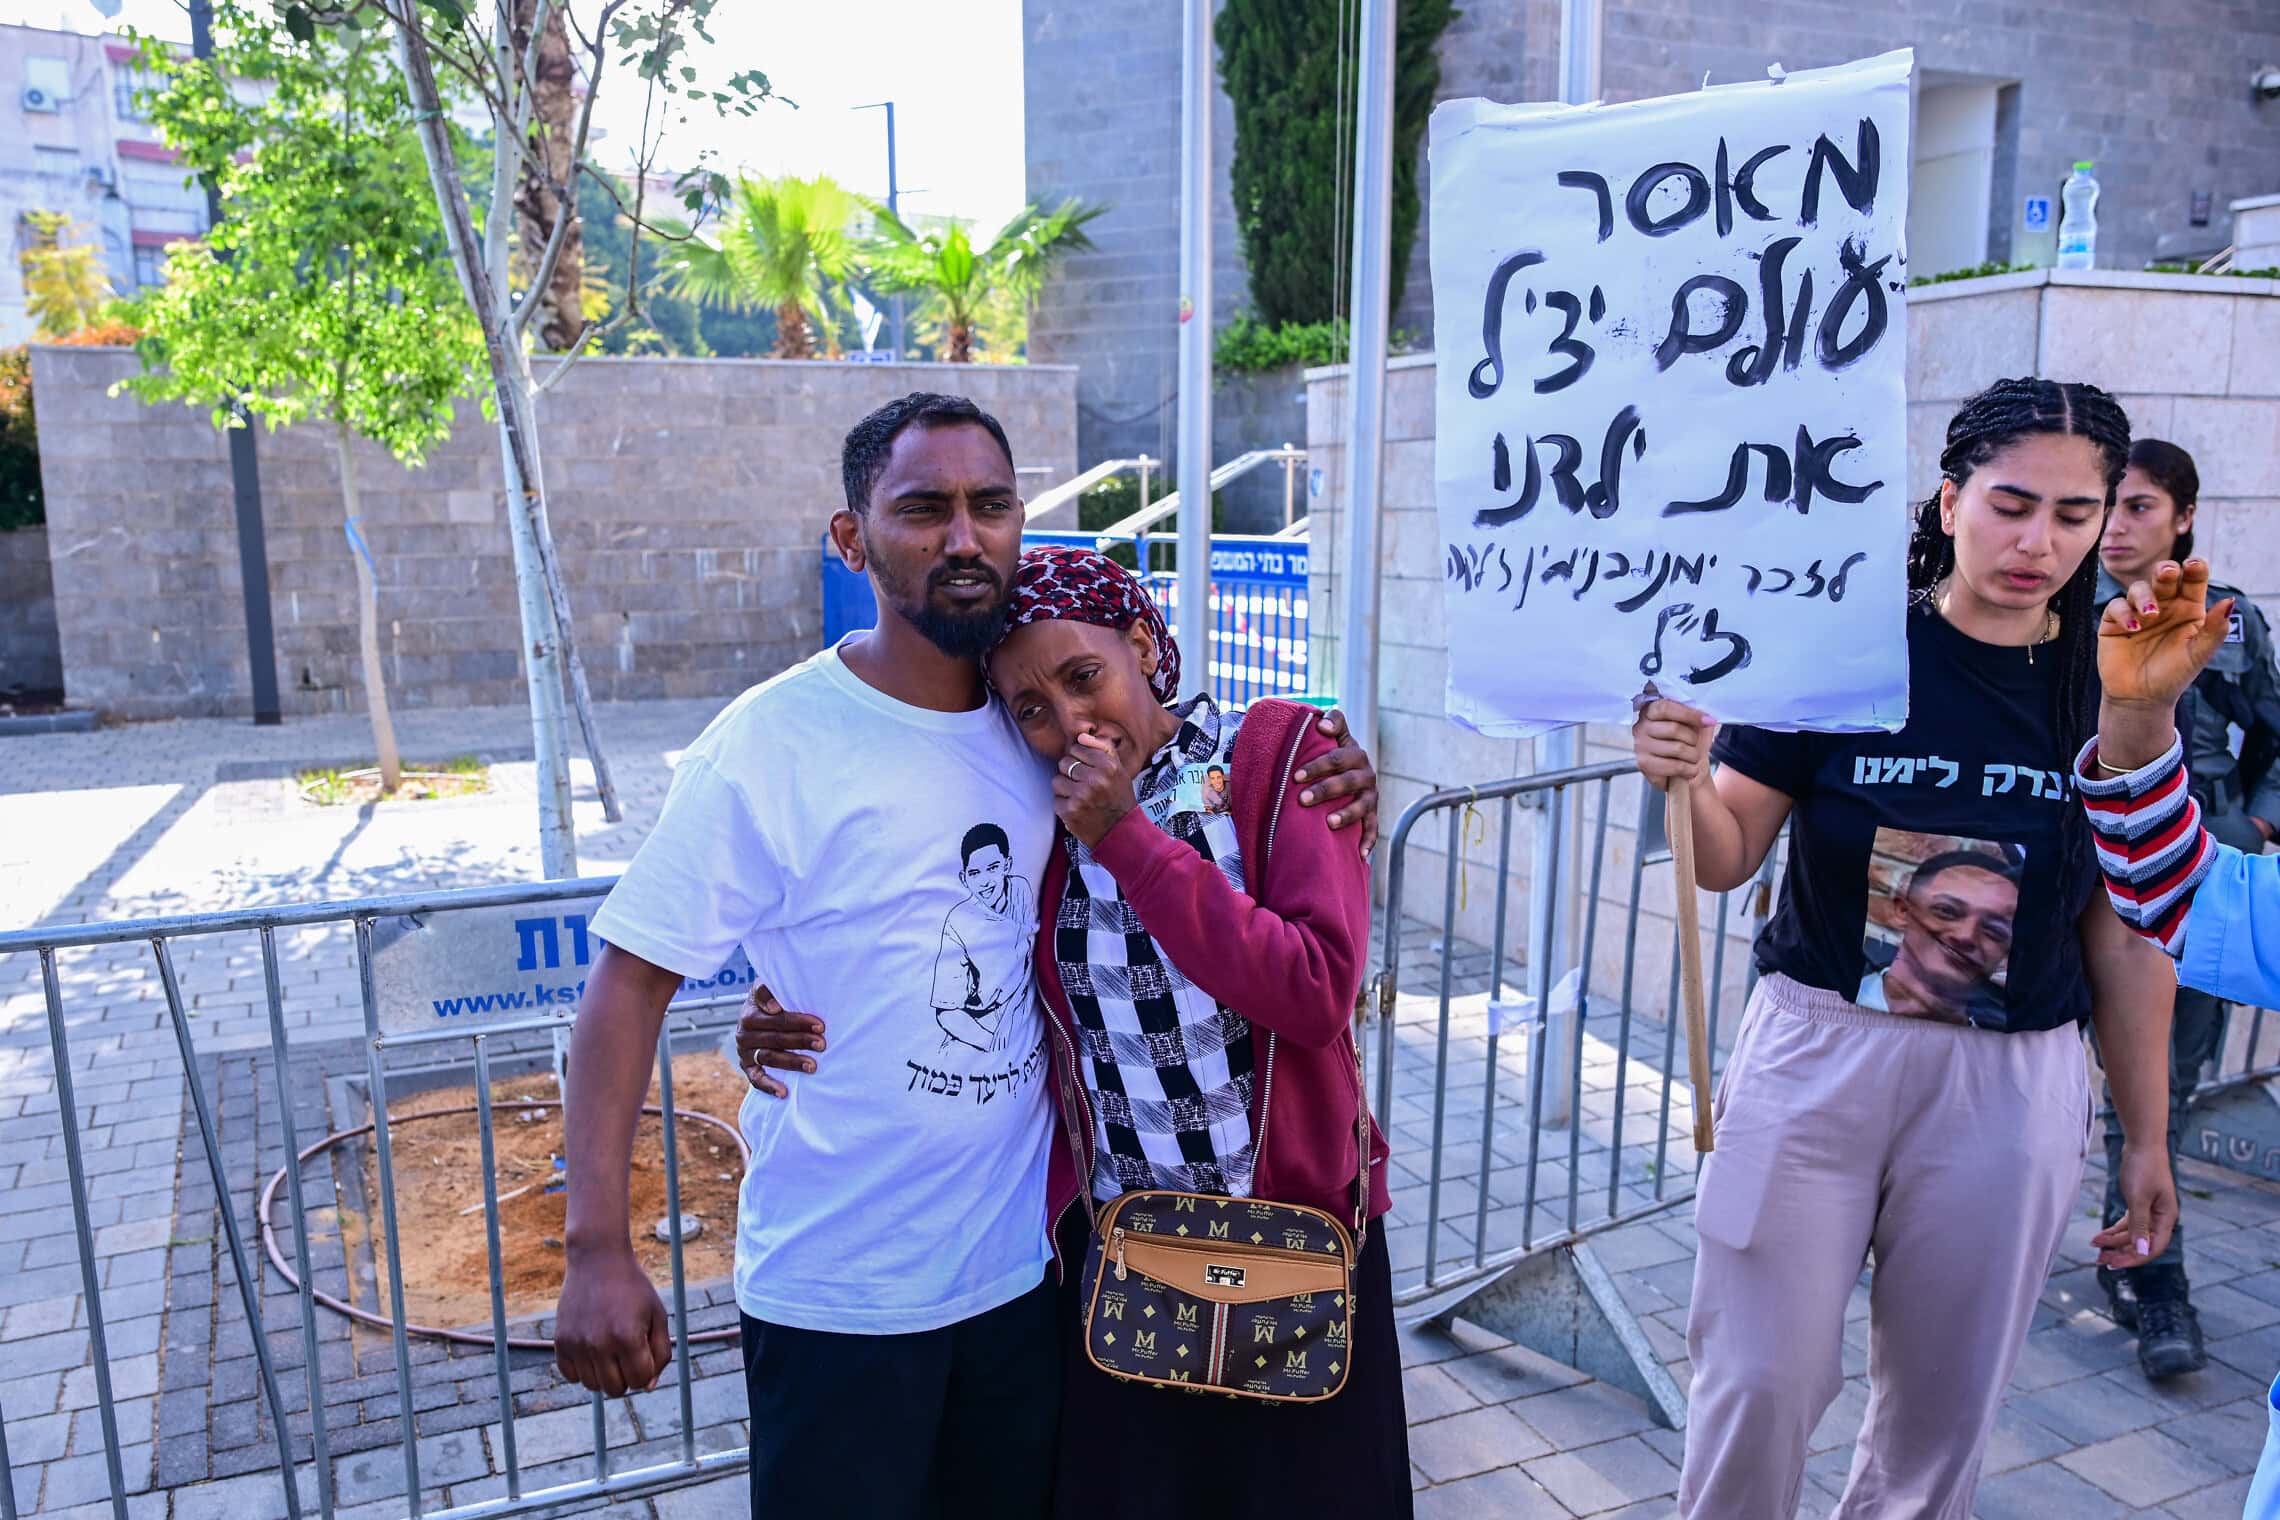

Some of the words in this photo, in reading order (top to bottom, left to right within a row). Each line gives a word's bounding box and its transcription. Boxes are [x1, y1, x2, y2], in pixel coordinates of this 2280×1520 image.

[1557, 116, 1881, 243] מאסר
[1653, 236, 1892, 387] עולם
[1468, 249, 1606, 400] יציל
[1660, 423, 1885, 517] את
[1852, 754, 1960, 788] לימנו
[1207, 1219, 1230, 1239] M
[1103, 1300, 1125, 1321] M
[1176, 1302, 1198, 1323] M
[1253, 1324, 1276, 1344] M
[1326, 1319, 1347, 1338] M
[1134, 1329, 1157, 1350] M
[1285, 1350, 1308, 1369] M
